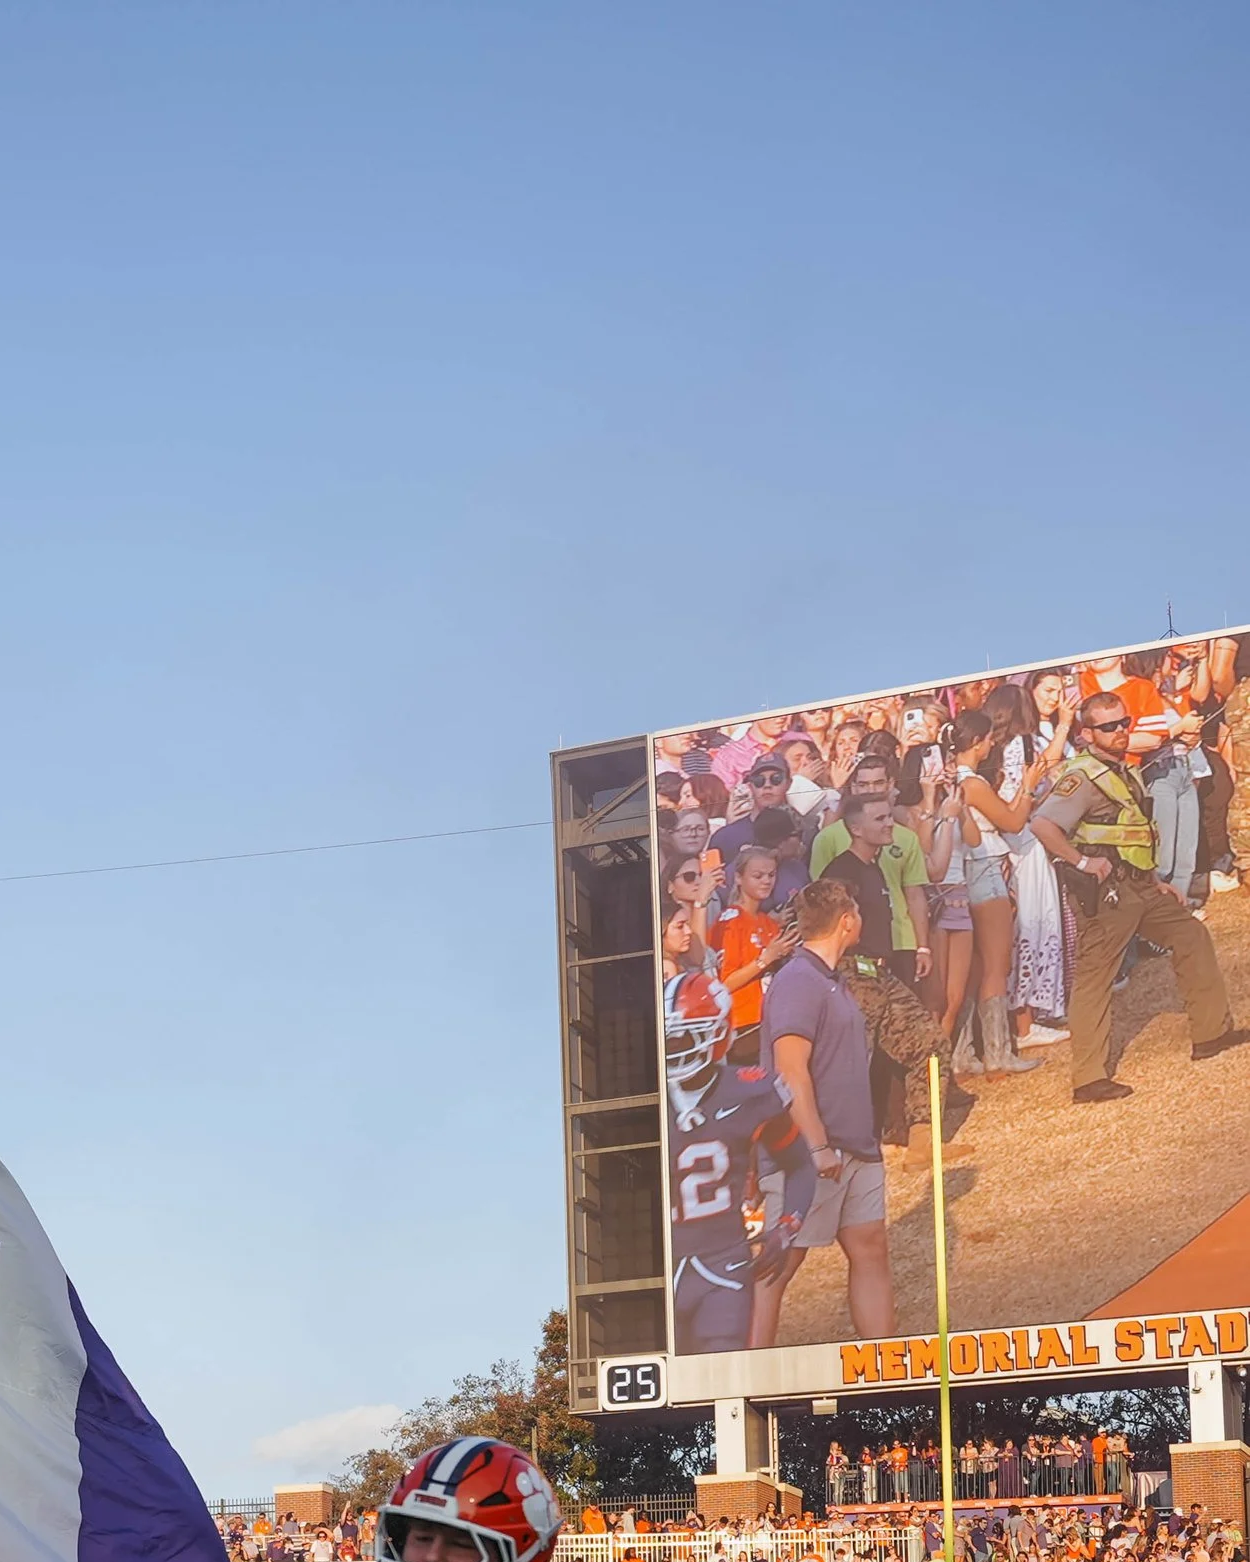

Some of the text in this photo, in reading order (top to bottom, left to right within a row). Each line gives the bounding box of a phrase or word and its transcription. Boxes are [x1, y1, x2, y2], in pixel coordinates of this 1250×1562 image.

[672, 1140, 732, 1222] 2
[613, 1366, 655, 1401] 25
[840, 1312, 1250, 1384] MEMORIAL STAD
